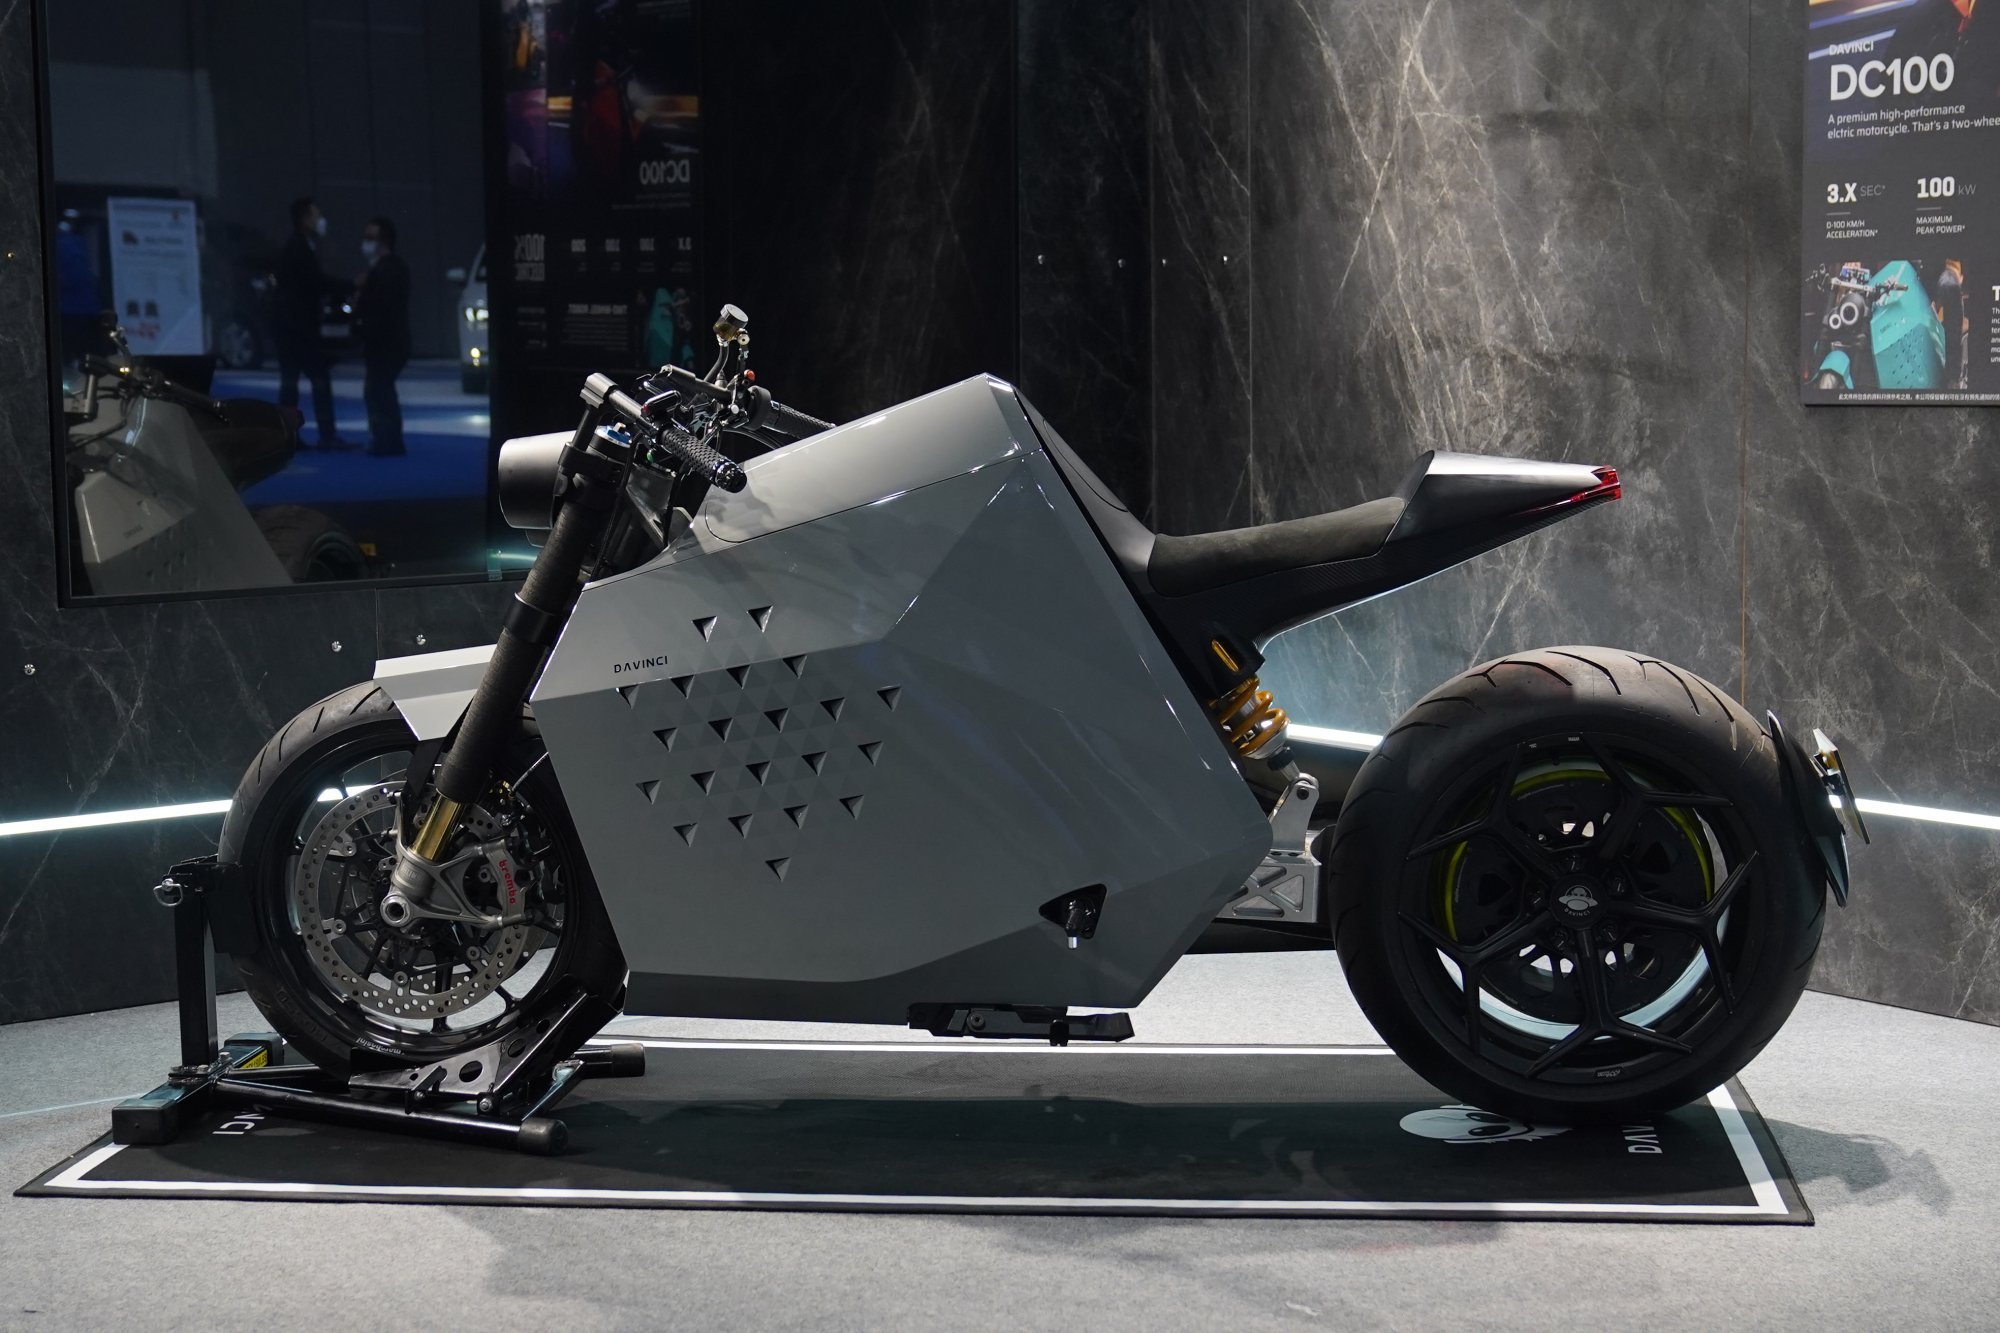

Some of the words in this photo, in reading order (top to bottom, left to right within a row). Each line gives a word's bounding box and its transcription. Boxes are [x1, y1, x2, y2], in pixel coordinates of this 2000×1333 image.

[1829, 40, 1874, 56] DAVINCI
[1830, 53, 1955, 101] DC100
[1827, 114, 1835, 125] A
[1837, 112, 1878, 126] premium
[1880, 105, 1965, 122] high-performance
[1857, 123, 1910, 137] motorcycle.
[1912, 120, 1941, 132] That's
[1943, 122, 1950, 131] a
[1827, 182, 1857, 204] 3.X
[1917, 176, 1955, 199] 100
[1846, 219, 1865, 228] KM/H
[1916, 215, 1953, 225] MAXIMUM
[1916, 226, 1935, 235] PEAK
[613, 655, 668, 674] DAVINCI
[499, 859, 517, 904] brembo
